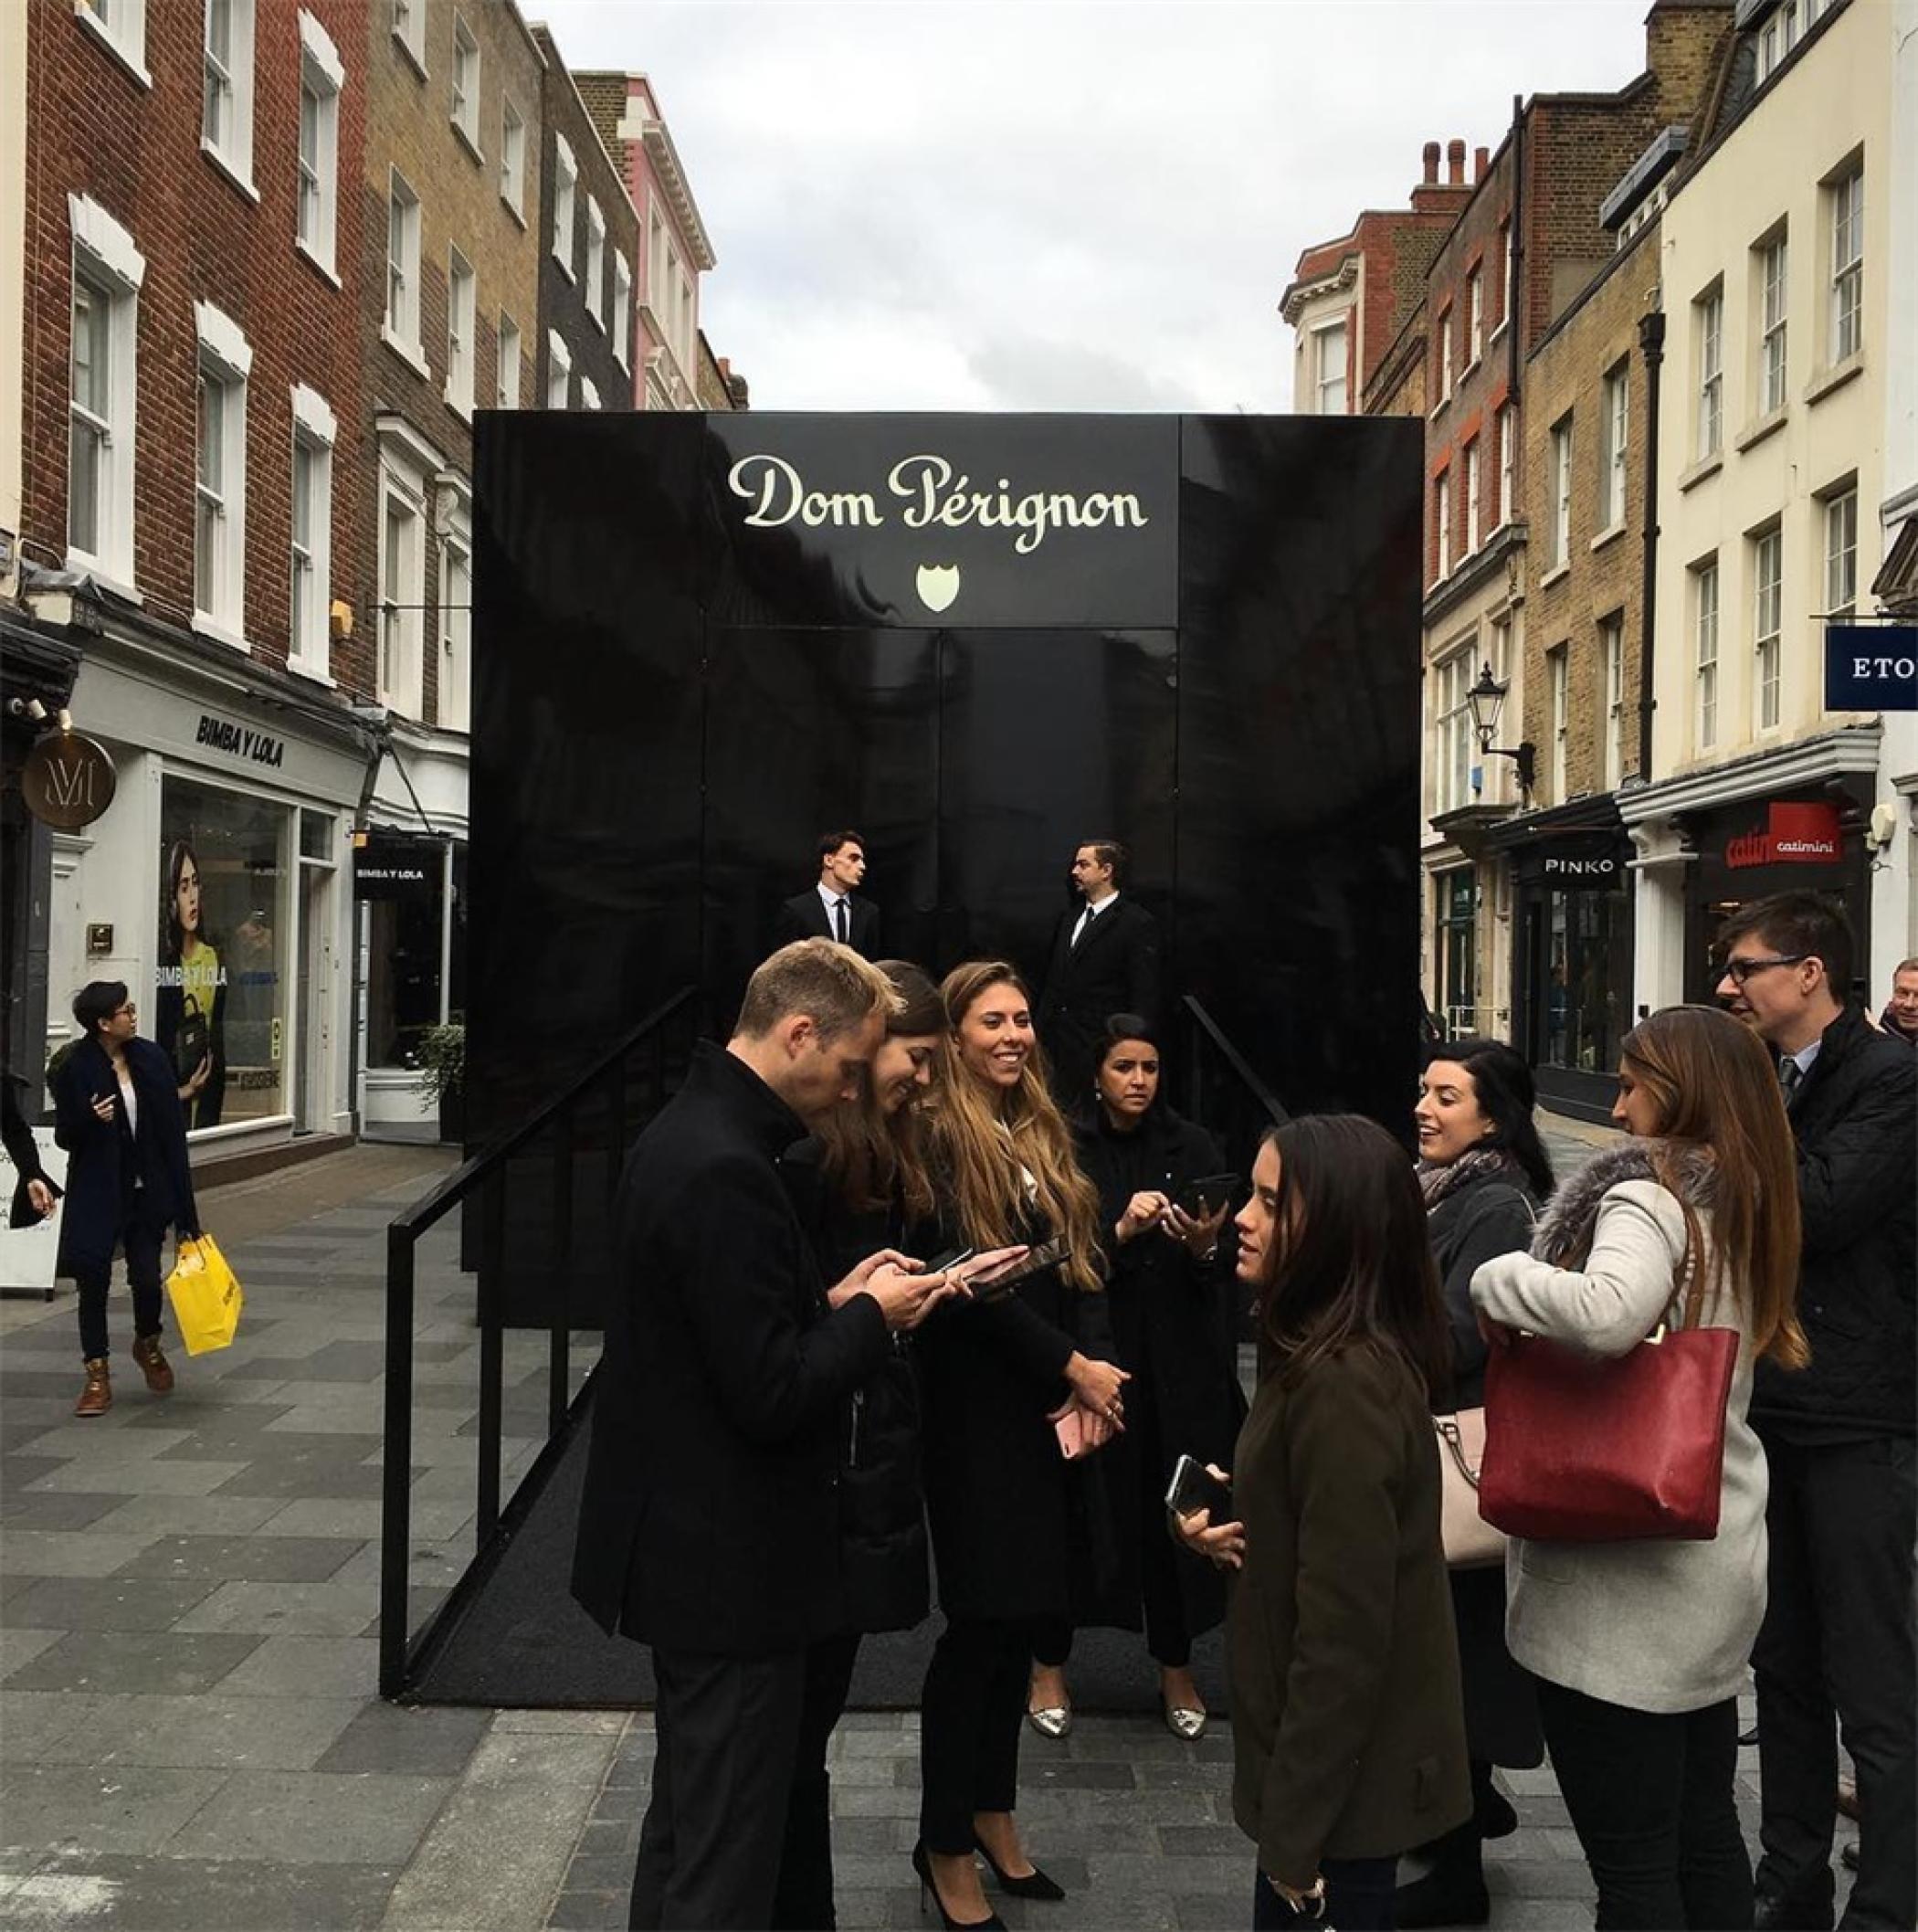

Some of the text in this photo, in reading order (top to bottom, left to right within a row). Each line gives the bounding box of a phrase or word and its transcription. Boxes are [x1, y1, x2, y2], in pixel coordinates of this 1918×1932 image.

[728, 455, 1149, 554] Dom Pérignon
[1851, 657, 1915, 679] ETO
[195, 715, 284, 768] BIMBA Y LOLA
[1776, 839, 1834, 853] catimini
[398, 869, 424, 880] LOLA
[1544, 859, 1614, 874] PINKO
